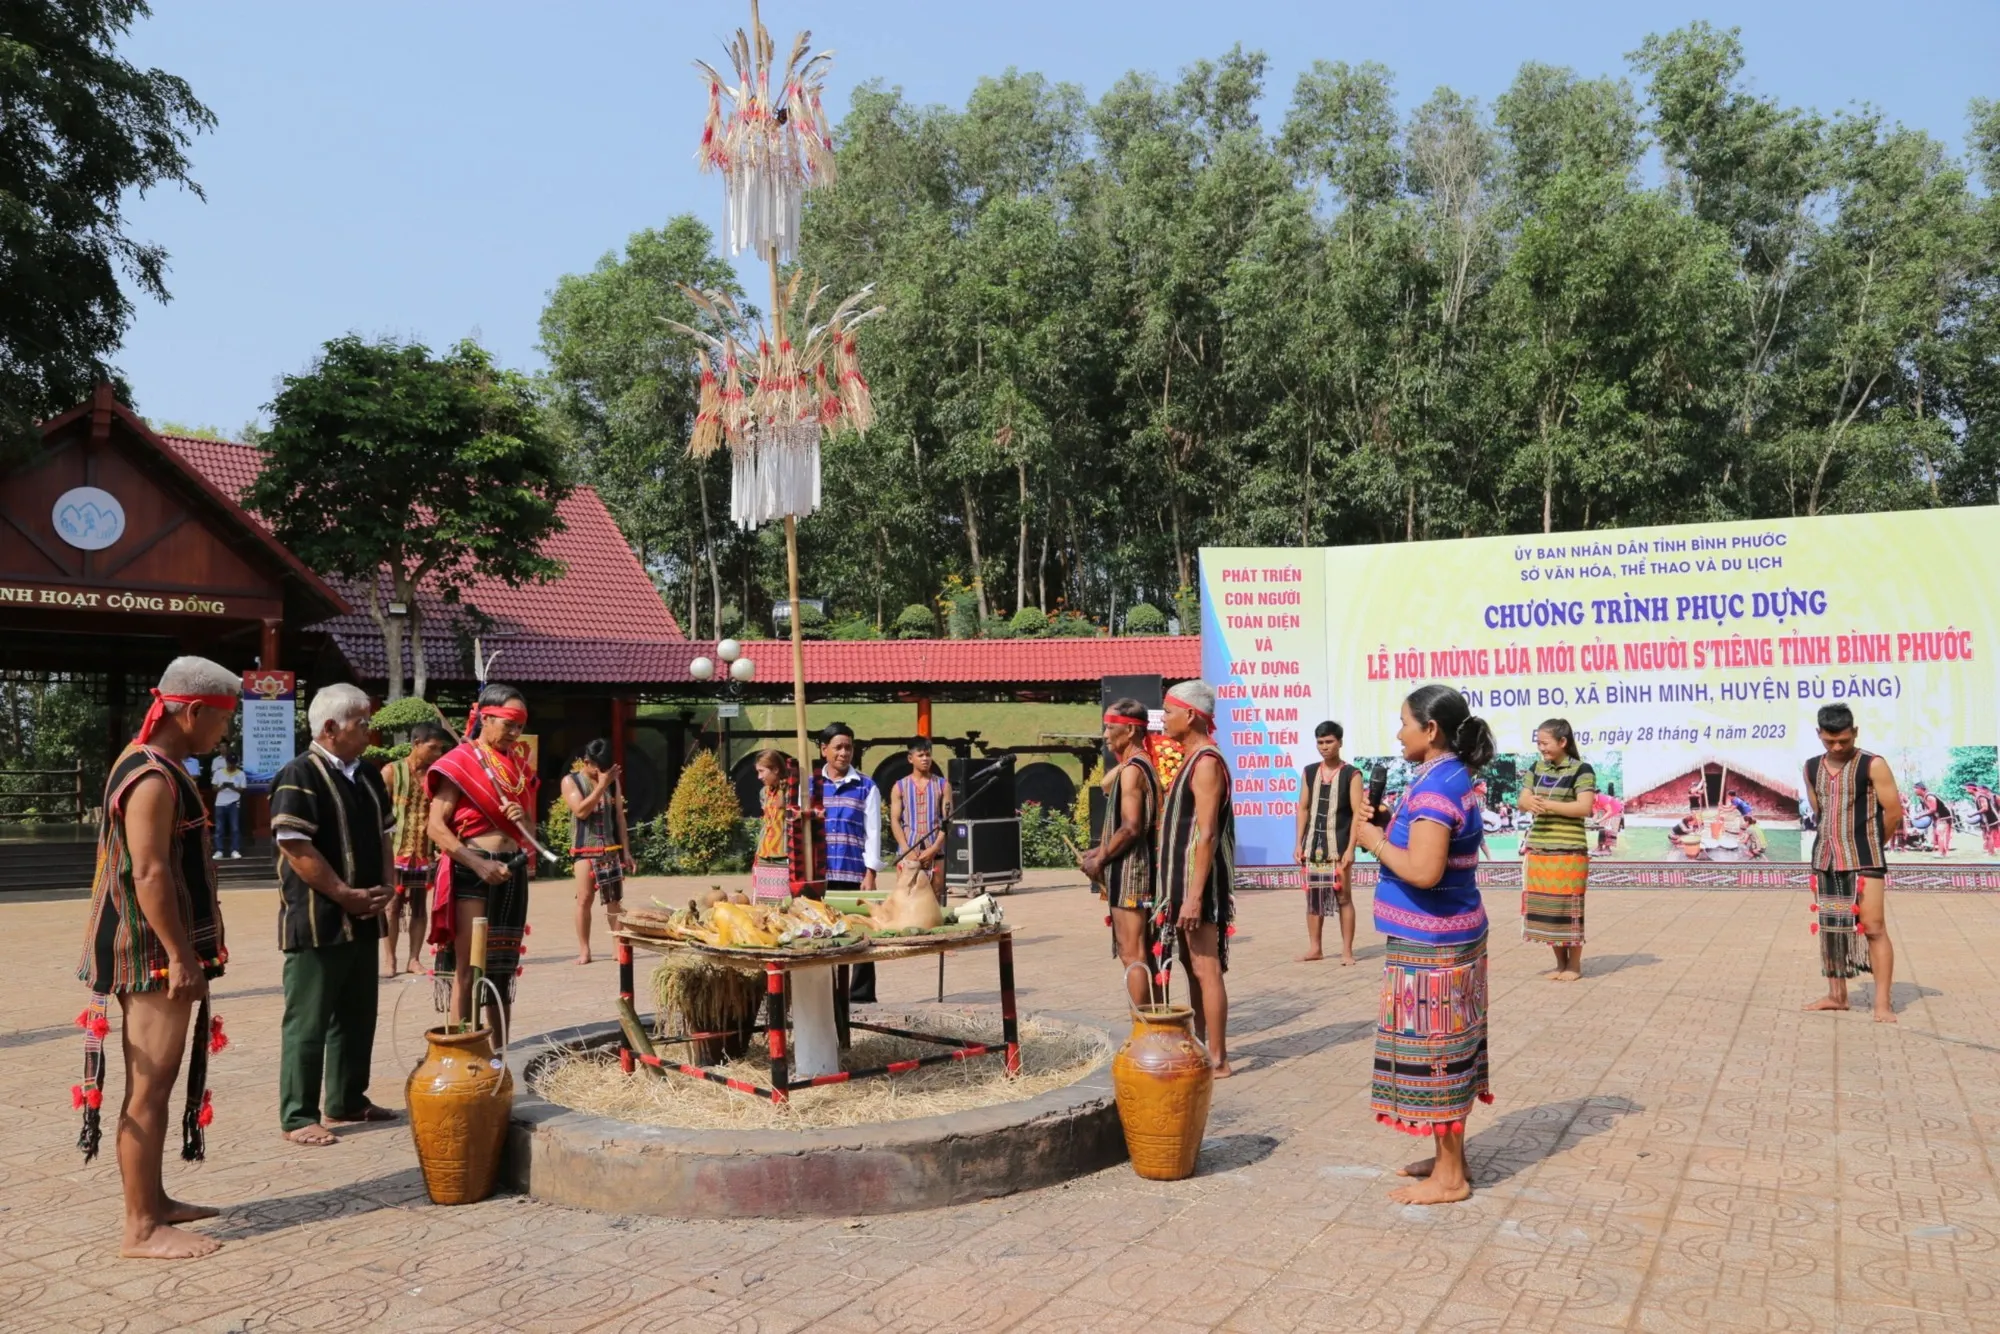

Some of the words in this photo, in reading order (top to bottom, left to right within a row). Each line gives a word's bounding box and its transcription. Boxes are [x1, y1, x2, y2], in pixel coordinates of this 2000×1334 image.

[1515, 546, 1532, 561] ỦY
[1537, 547, 1566, 560] BAN
[1571, 541, 1611, 558] NHÂN
[1618, 540, 1648, 556] DÂN
[1653, 536, 1686, 552] TỈNH
[1692, 535, 1727, 551] BÌNH
[1732, 533, 1787, 549] PHƯỚC
[1222, 567, 1257, 582] PHÁT
[1262, 564, 1302, 582] TRIỂN
[1521, 566, 1540, 581] SỞ
[1545, 564, 1575, 580] VĂN
[1580, 563, 1617, 579] HÓA,
[1621, 558, 1646, 576] THỂ
[1650, 561, 1691, 575] THAO
[1696, 559, 1716, 573] VÀ
[1722, 558, 1742, 571] DU
[1747, 556, 1783, 573] LỊCH
[39, 590, 100, 608] HOẠT
[106, 592, 164, 611] CỘNG
[169, 594, 225, 614] ĐỒNG
[1225, 592, 1253, 605] CON
[1258, 589, 1301, 605] NGƯỜI
[1484, 599, 1585, 629] CHƯƠNG
[1591, 592, 1669, 624] TRÌNH
[1676, 593, 1744, 627] PHỤC
[1752, 587, 1827, 624] DỰNG
[1226, 613, 1263, 628] TOÀN
[1268, 613, 1300, 631] DIỆN
[1255, 636, 1273, 652] VÀ
[1367, 643, 1390, 680] LỄ
[1394, 646, 1426, 684] HỘI
[1430, 645, 1489, 678] MỪNG
[1494, 642, 1531, 675] LÚA
[1536, 641, 1576, 673] MỚI
[1580, 636, 1619, 671] CỦA
[1624, 635, 1688, 670] NGƯỜI
[1779, 629, 1831, 665] TỈNH
[1836, 629, 1891, 663] BÌNH
[1897, 625, 1972, 662] PHƯỚC
[1230, 659, 1256, 675] XÂY
[1262, 660, 1300, 678] DỰNG
[1251, 683, 1279, 698] VĂN
[1284, 682, 1311, 697] HÓA
[1490, 688, 1531, 707] BOM
[1538, 687, 1569, 708] BO,
[1575, 682, 1600, 704] XÃ
[1607, 680, 1652, 703] BÌNH
[1659, 682, 1715, 704] MINH,
[1721, 677, 1790, 703] HUYỆN
[1797, 675, 1825, 698] BÙ
[1832, 674, 1901, 699] ĐĂNG)
[1232, 707, 1260, 725] VIỆT
[1265, 708, 1298, 721] NAM
[1232, 730, 1263, 745] TIÊN
[1268, 727, 1298, 744] TIẾN
[1599, 728, 1633, 745] ngày
[1637, 727, 1654, 740] 28
[1658, 726, 1699, 743] tháng
[1703, 725, 1711, 739] 4
[1716, 725, 1747, 739] năm
[1751, 724, 1786, 739] 2023
[1237, 753, 1270, 771] ĐẬM
[1274, 753, 1293, 768] ĐÀ
[1235, 774, 1264, 792] BẢN
[1269, 774, 1296, 791] SẮC
[1233, 801, 1262, 816] DÂN
